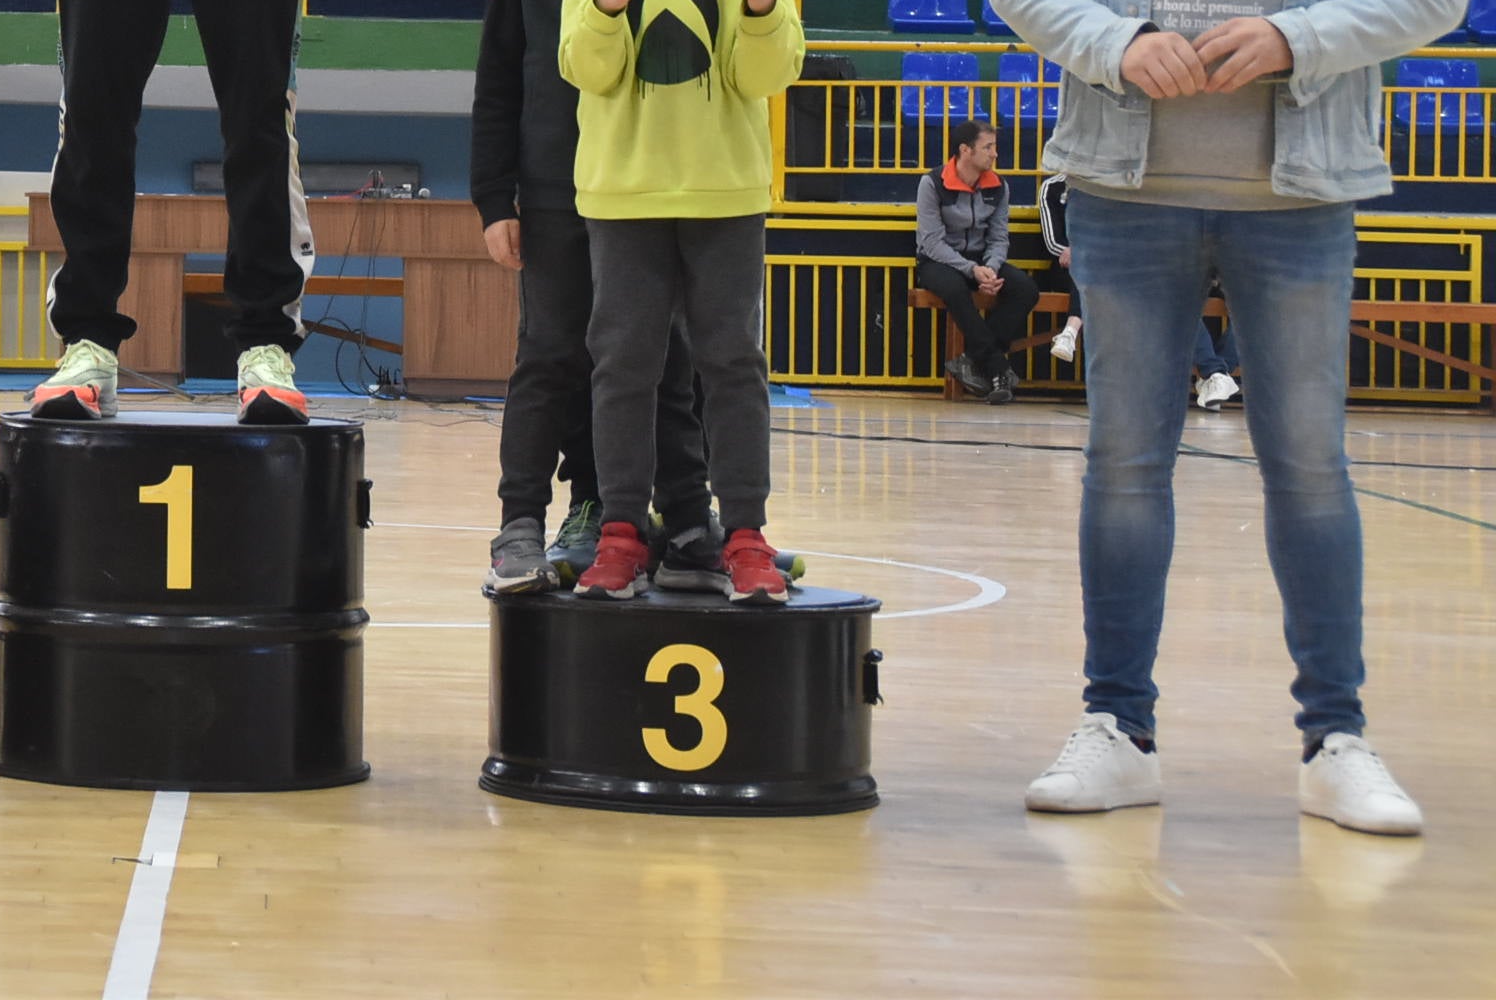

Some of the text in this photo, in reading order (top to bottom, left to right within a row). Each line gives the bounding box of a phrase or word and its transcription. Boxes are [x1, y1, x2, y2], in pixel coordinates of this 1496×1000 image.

[1164, 13, 1178, 28] de
[1180, 14, 1191, 29] lo
[1208, 2, 1264, 17] presumir
[139, 465, 194, 590] 1
[641, 643, 728, 772] 3
